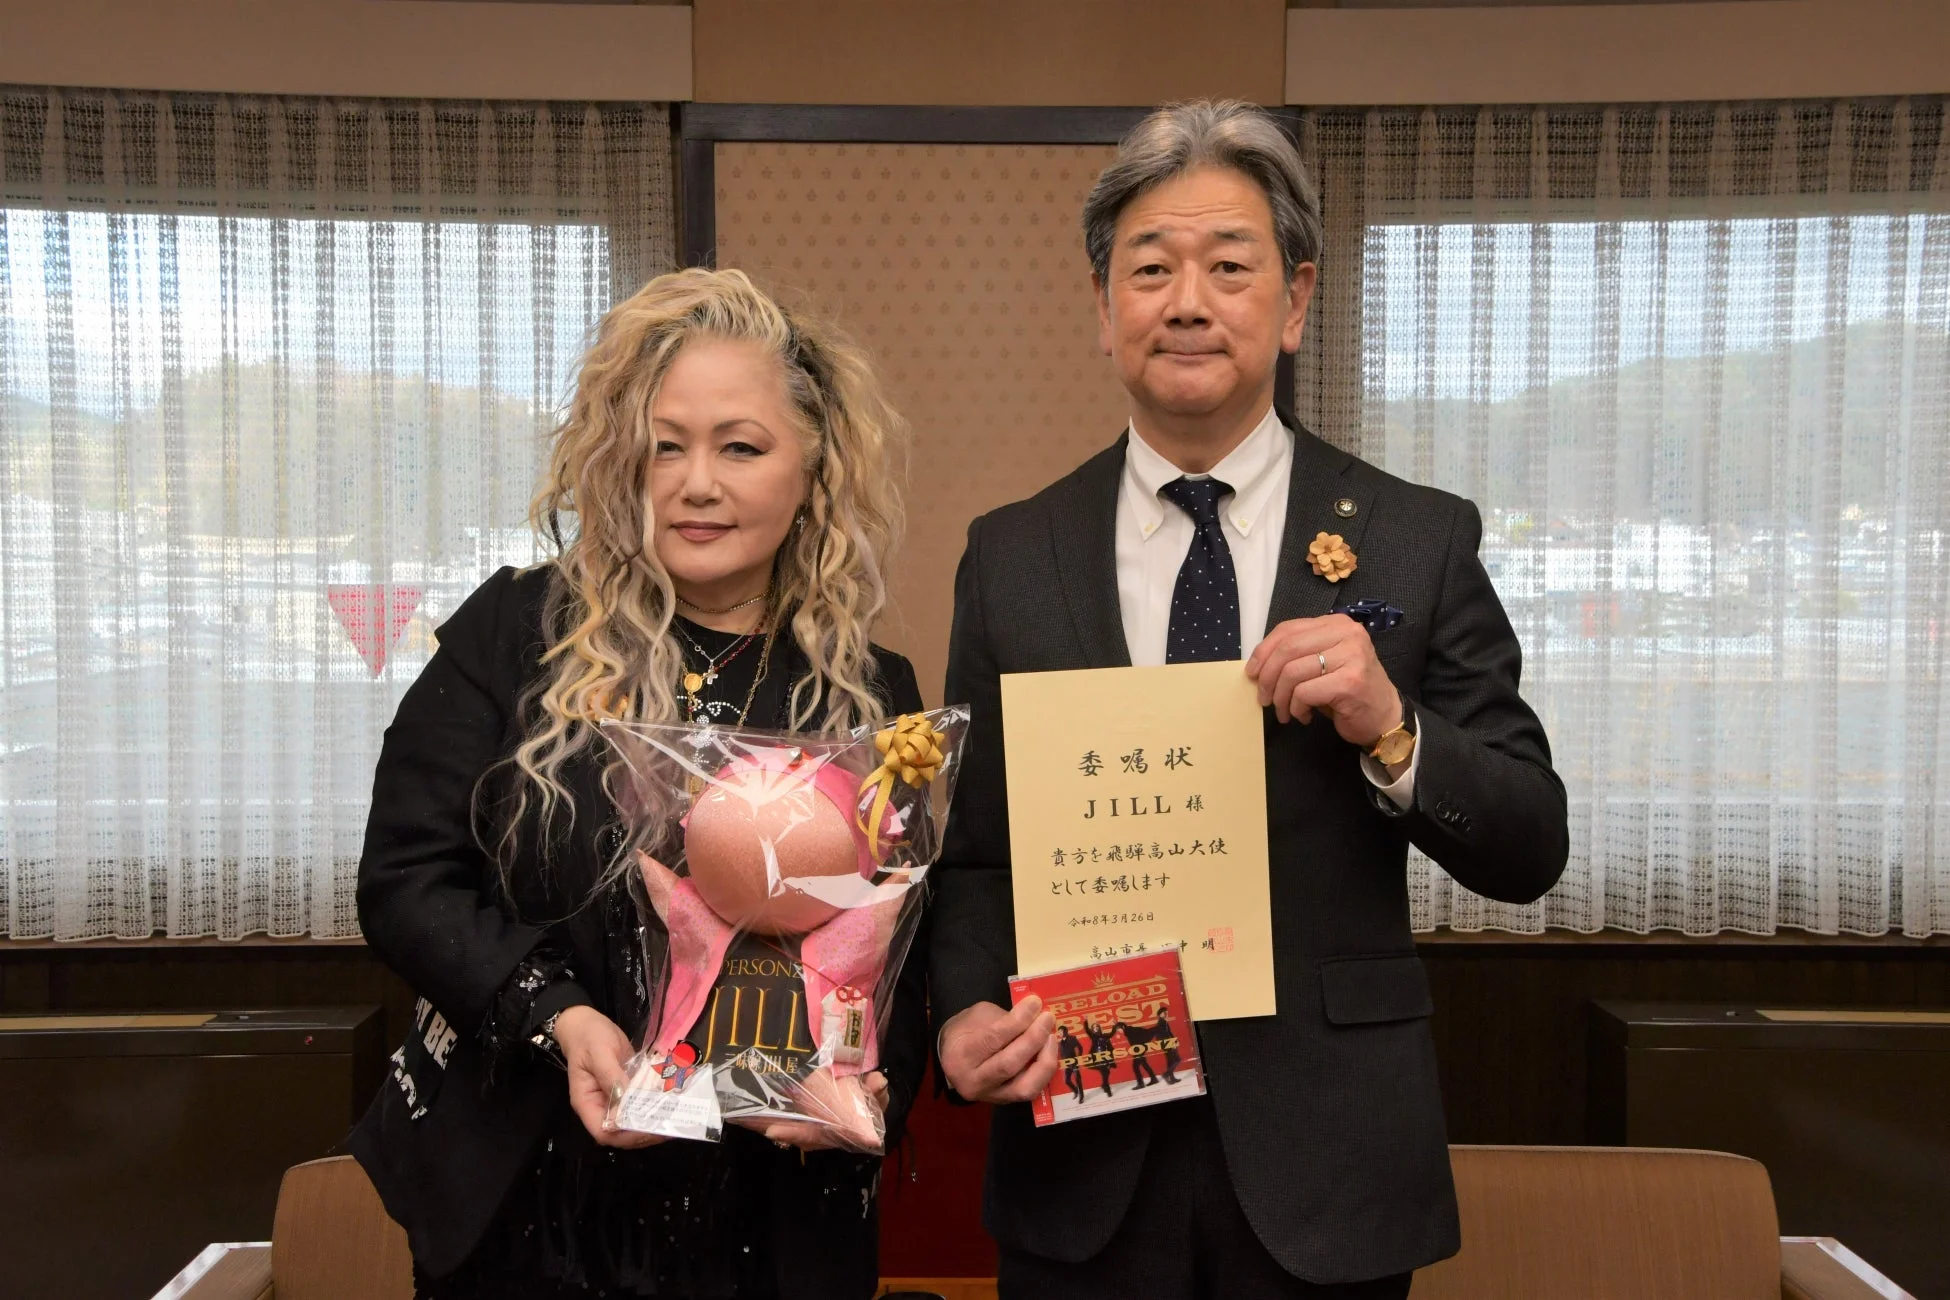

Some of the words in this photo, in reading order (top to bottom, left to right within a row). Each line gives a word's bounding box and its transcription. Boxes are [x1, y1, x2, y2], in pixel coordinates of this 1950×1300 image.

[1078, 746, 1194, 777] 委嘱状
[1083, 795, 1171, 819] JILL
[1185, 794, 1204, 812] 様
[1050, 838, 1229, 867] 貴方を飛騨高山大使
[1050, 872, 1171, 896] として委嘱します
[1068, 911, 1155, 928] 令和8年3月26日
[1047, 983, 1167, 1013] RELOAD
[701, 986, 811, 1064] JILL
[1055, 998, 1170, 1036] BEST
[1059, 1036, 1180, 1070] PERSONZ
